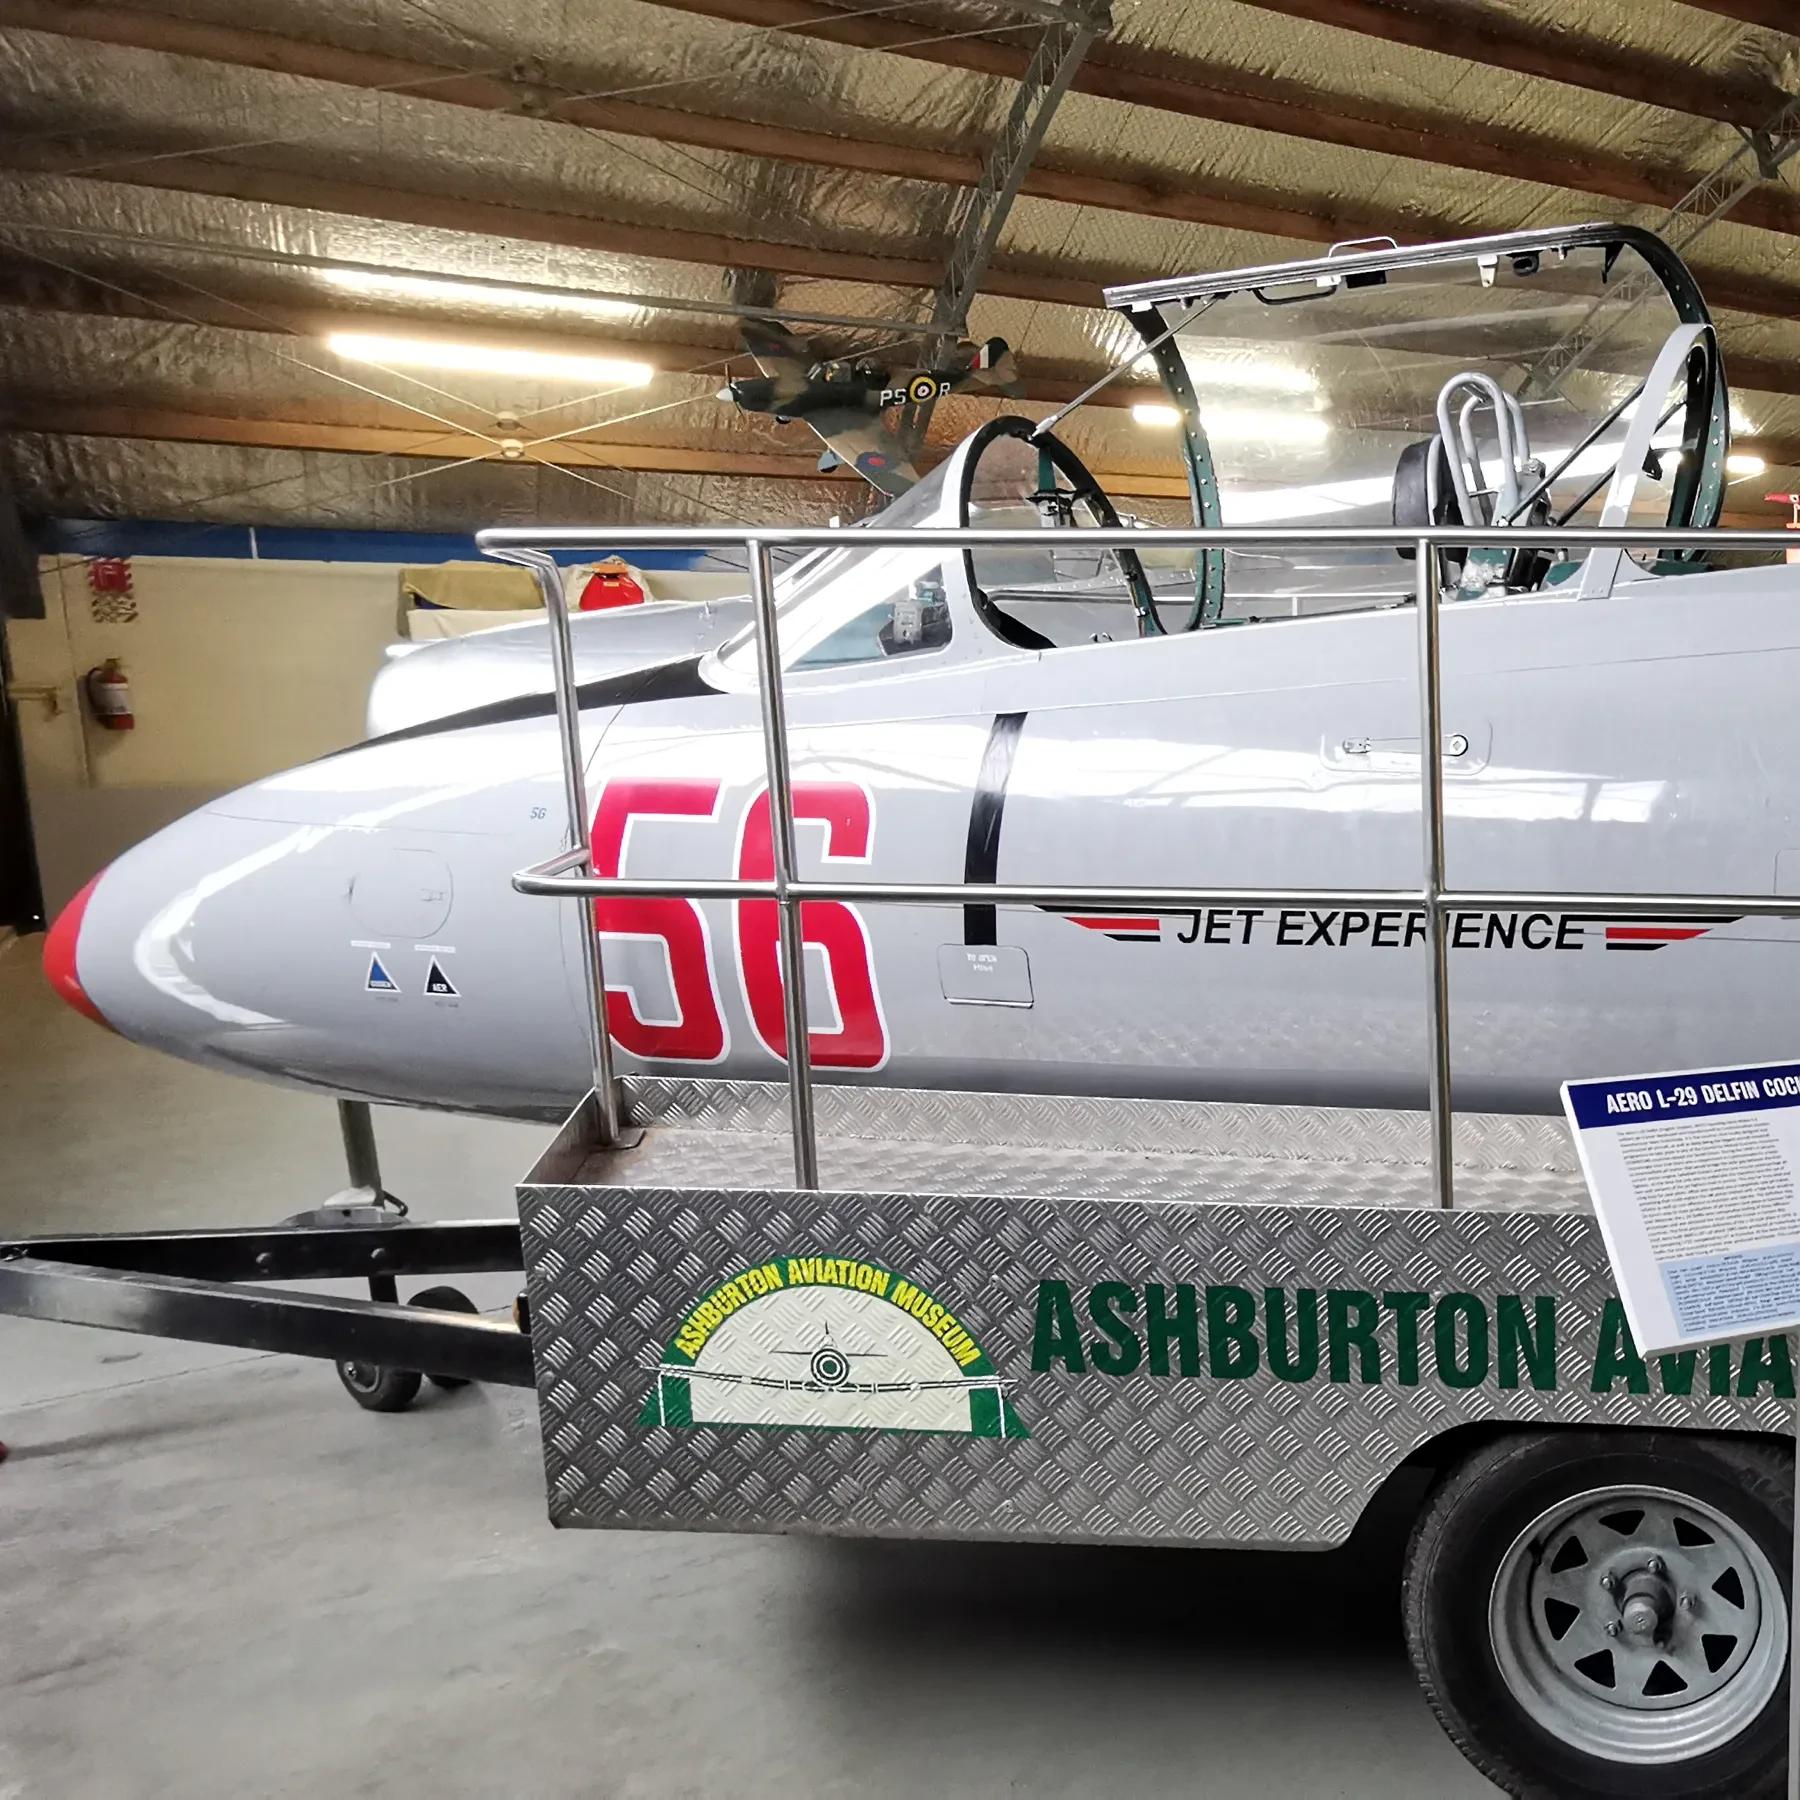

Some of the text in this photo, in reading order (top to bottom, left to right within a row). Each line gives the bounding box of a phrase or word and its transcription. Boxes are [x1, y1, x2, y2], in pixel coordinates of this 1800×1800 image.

[879, 387, 907, 407] PS
[589, 777, 890, 1072] 56
[1177, 909, 1587, 950] JET EXPERENCE
[1606, 1090, 1653, 1114] AERO
[1655, 1086, 1698, 1109] L-29
[1700, 1080, 1761, 1105] DELFIN
[672, 1257, 982, 1367] ASHBURTON AVIATION MUSEUM
[1030, 1279, 1558, 1392] ASHBURTON
